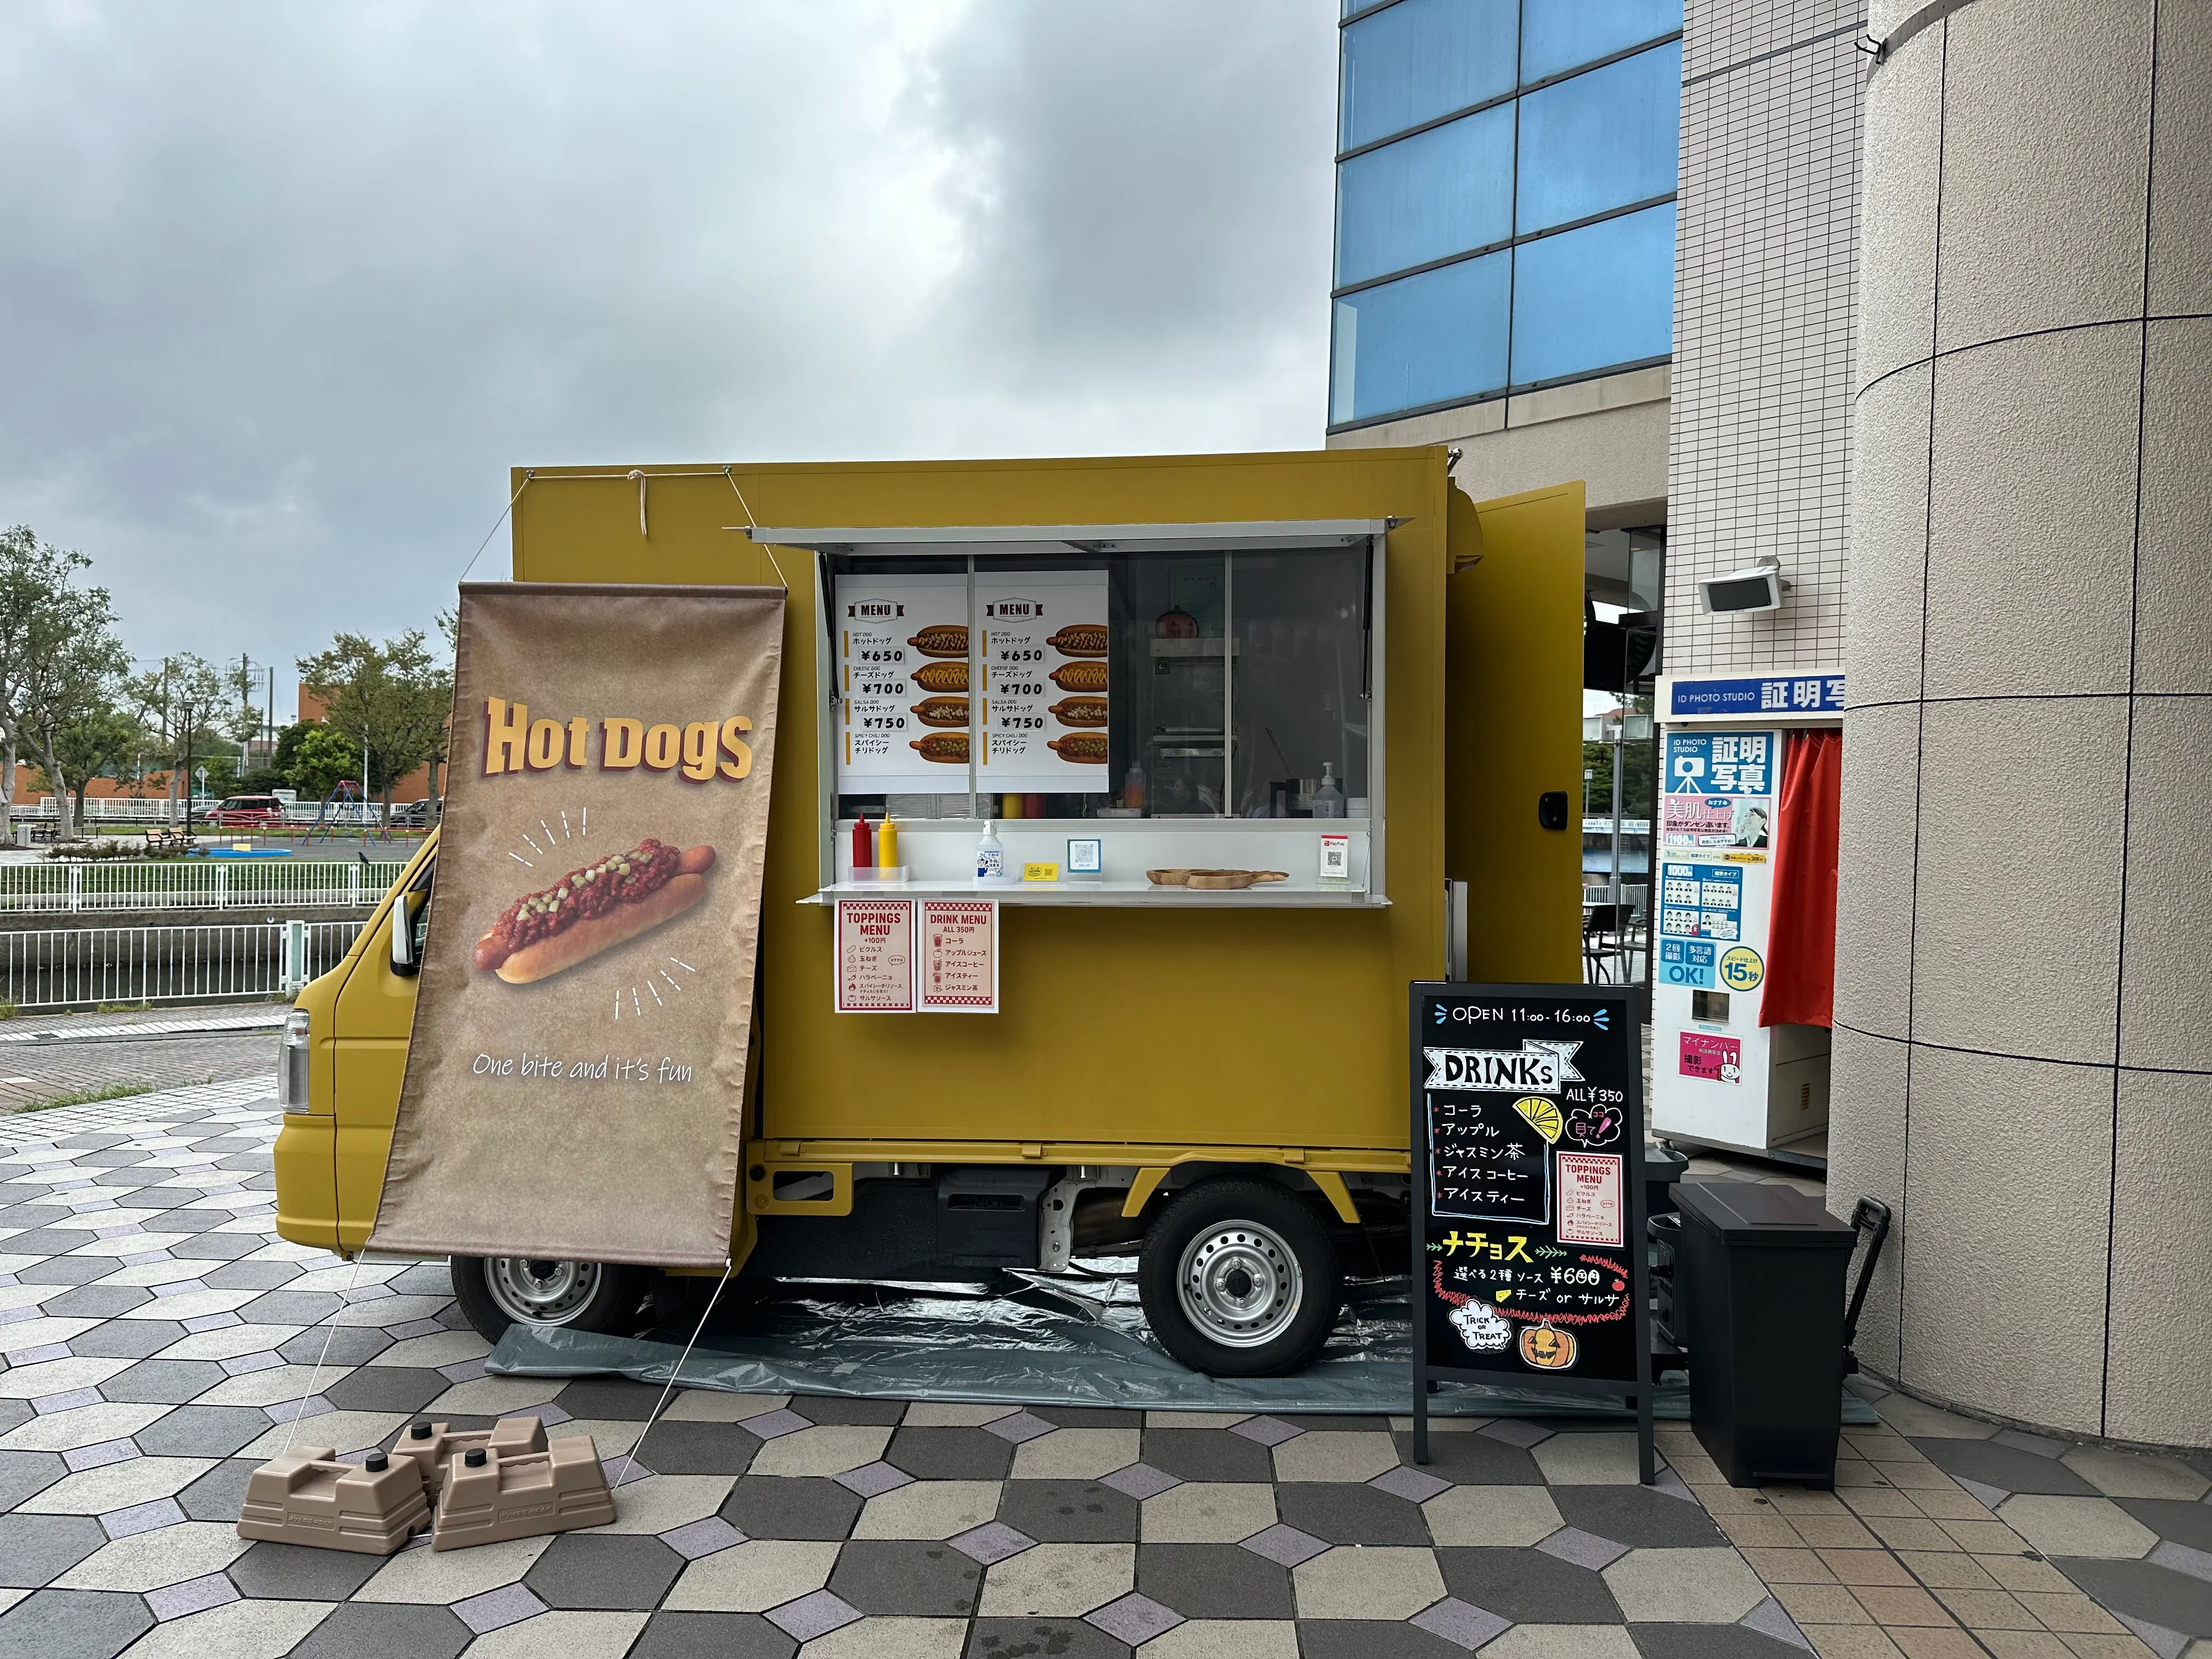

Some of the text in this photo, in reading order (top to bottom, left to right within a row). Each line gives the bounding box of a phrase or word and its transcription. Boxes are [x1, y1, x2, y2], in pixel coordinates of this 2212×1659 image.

[861, 605, 891, 616] MENU
[1000, 604, 1029, 615] MENU
[853, 636, 892, 645] ホットドッグ
[861, 651, 902, 662] ¥650
[1000, 650, 1042, 662] ¥650
[853, 670, 895, 679] チーズドッグ
[862, 683, 904, 695] ¥700
[1001, 684, 1042, 695] ¥700
[1678, 695, 1686, 703] ID
[1690, 693, 1720, 702] PHOTO
[1722, 692, 1755, 701] STUDIO
[854, 704, 895, 713] サルサドッグ
[864, 718, 905, 729] ¥750
[1001, 718, 1043, 729] ¥750
[854, 746, 888, 754] チリドッグ
[991, 746, 1026, 754] チリドッグ
[1712, 736, 1766, 763] 証明
[1711, 764, 1765, 792] 写真
[847, 913, 901, 923] TOPPINGS
[930, 915, 986, 924] DRINK MENU
[860, 924, 890, 935] MENU
[1666, 943, 1680, 952] 2回
[1689, 945, 1712, 955] 多言語
[1665, 952, 1681, 961] 撮影
[1692, 954, 1708, 963] 対応
[1669, 966, 1704, 985] OK!
[1452, 1006, 1504, 1024] OPEN
[473, 1052, 692, 1084] One bite and it's fun
[1688, 1065, 1714, 1074] できます
[1444, 1104, 1482, 1118] コーラ
[1441, 1122, 1500, 1138] アップル
[1444, 1142, 1526, 1160] ジャスミン茶
[1565, 1164, 1611, 1175] TOPPINGS
[1577, 1175, 1602, 1184] MENU
[1443, 1231, 1534, 1263] ナチョス
[1550, 1266, 1600, 1285] ¥600
[1516, 1288, 1620, 1307] チーズ or サルサ
[1463, 1314, 1491, 1325] TRICK
[1474, 1332, 1503, 1341] TREAT
